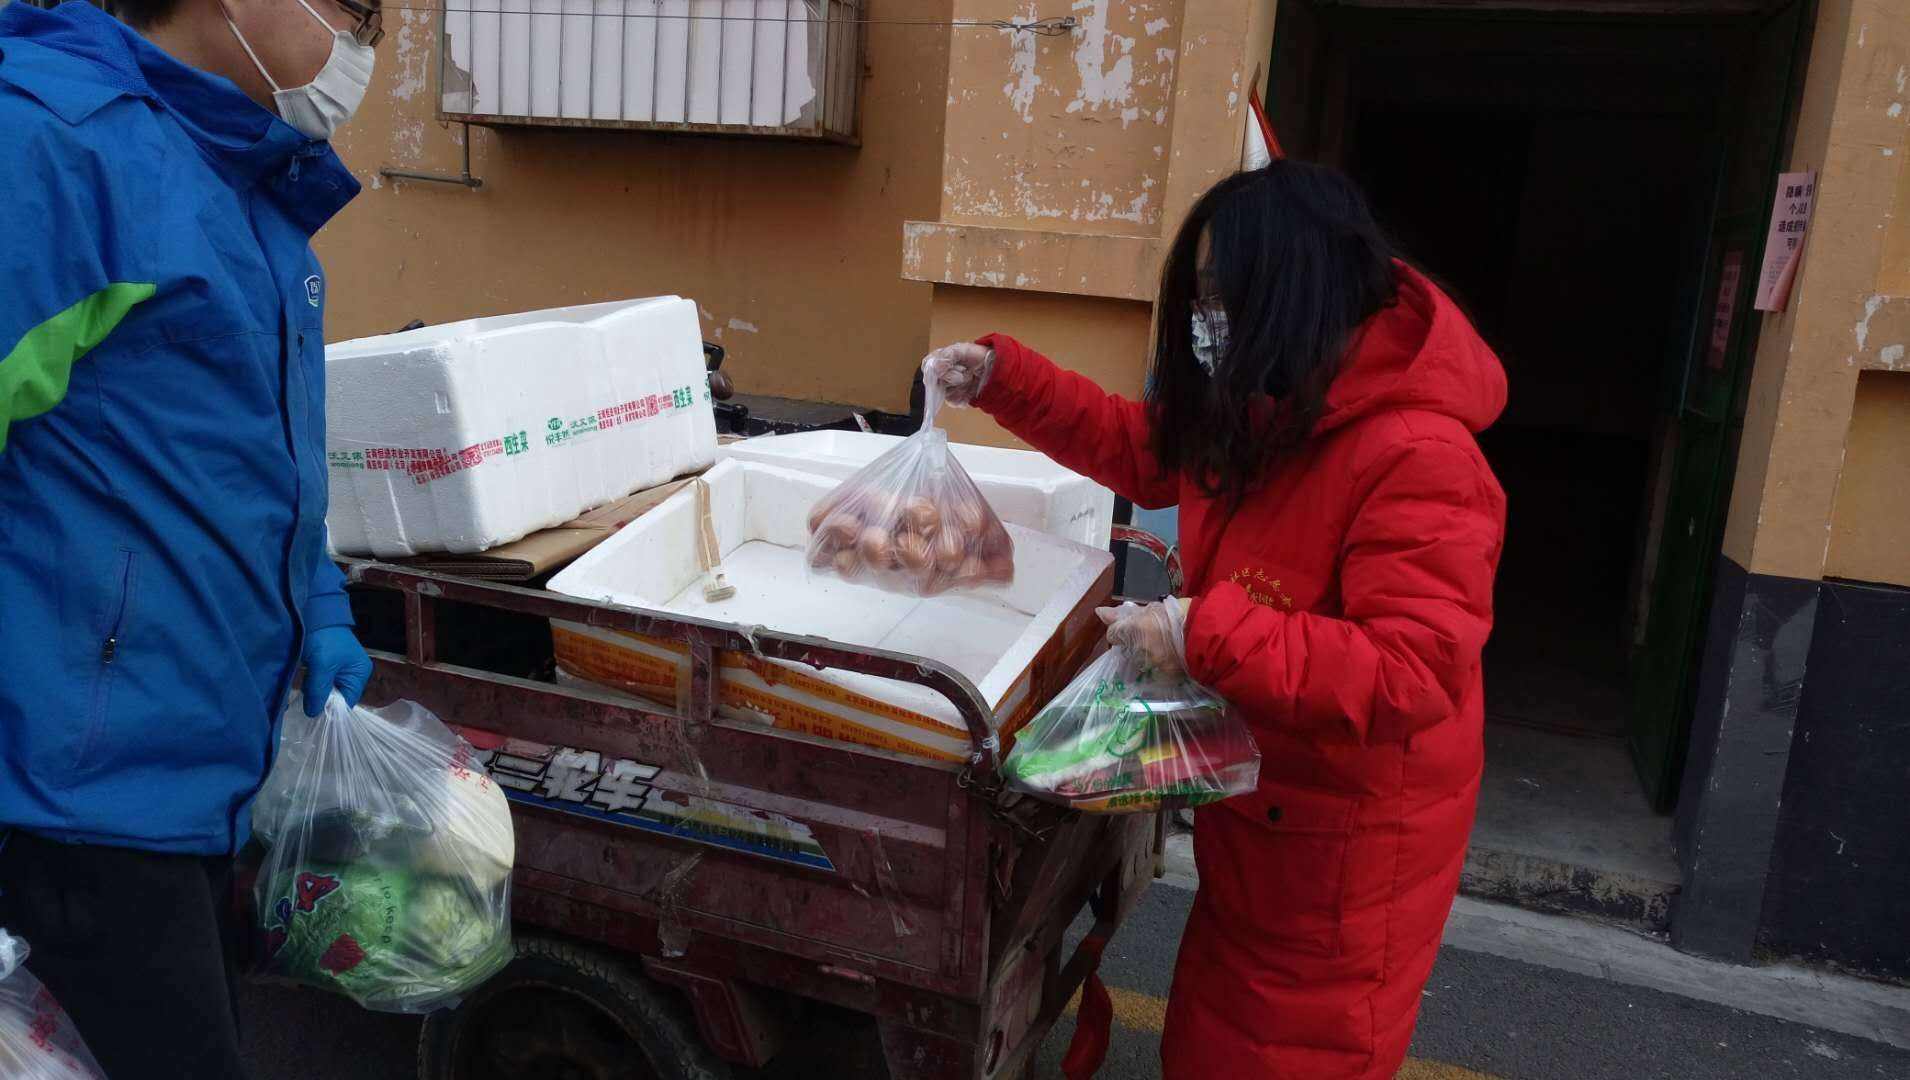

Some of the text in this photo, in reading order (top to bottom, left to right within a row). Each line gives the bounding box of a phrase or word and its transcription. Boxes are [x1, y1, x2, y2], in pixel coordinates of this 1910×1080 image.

[672, 386, 694, 409] 西生菜
[503, 430, 529, 456] 西生菜
